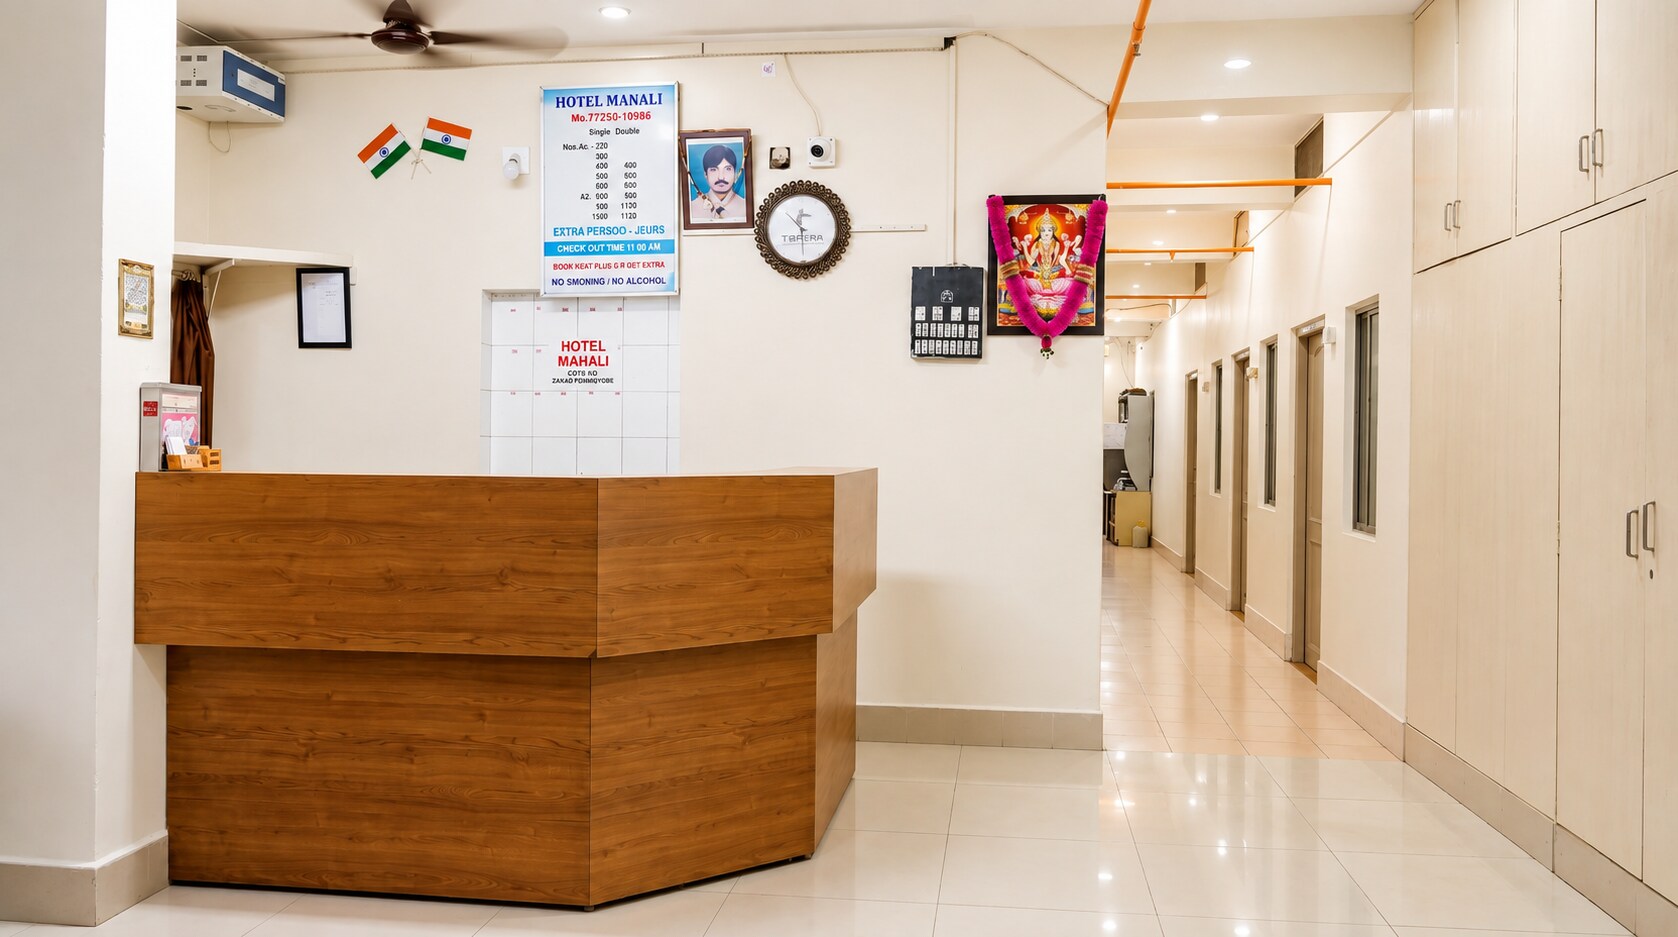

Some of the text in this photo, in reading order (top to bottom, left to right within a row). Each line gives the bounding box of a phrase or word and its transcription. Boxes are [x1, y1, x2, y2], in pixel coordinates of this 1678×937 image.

[555, 93, 663, 109] HOTEL MANALI
[589, 127, 640, 137] Single Double
[595, 142, 609, 150] 220
[553, 227, 585, 237] EXTRA
[557, 245, 586, 253] CHECK
[648, 243, 661, 251] AM
[642, 261, 665, 269] EXTRA
[552, 278, 564, 286] NO
[612, 277, 624, 285] NO
[626, 276, 666, 285] ALCOHOL
[561, 340, 606, 352] HOTEL
[558, 355, 609, 367] MAHALI
